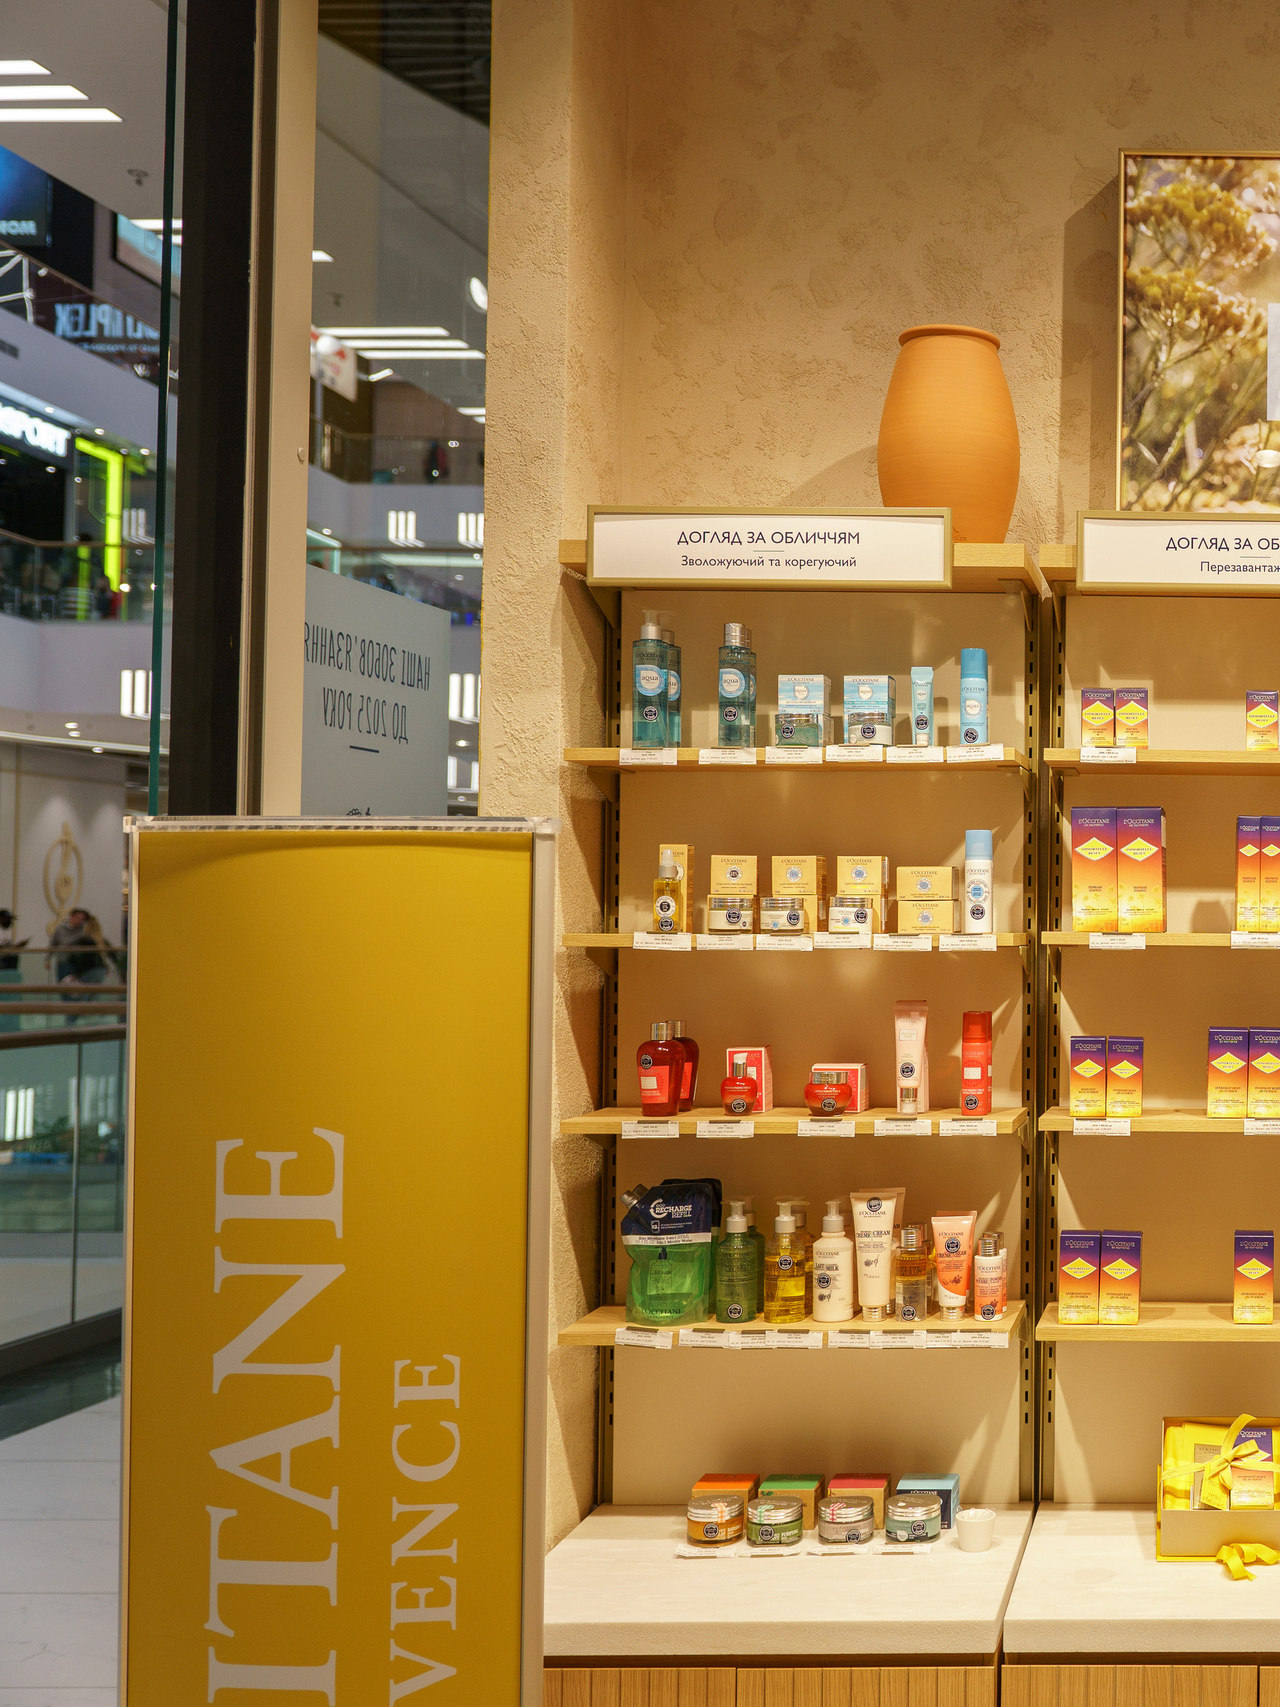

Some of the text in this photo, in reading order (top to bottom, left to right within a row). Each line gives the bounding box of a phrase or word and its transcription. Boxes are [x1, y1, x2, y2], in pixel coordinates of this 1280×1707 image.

[676, 530, 861, 547] ДОГЛЯД ЗА ОБЛИЧЧЯМ
[1166, 536, 1230, 552] ДОГЛЯД
[1234, 537, 1253, 551] ЗА
[680, 554, 858, 570] Зволожуючий та корегуючий
[641, 675, 658, 683] aqua
[656, 1205, 692, 1214] RECHARGE
